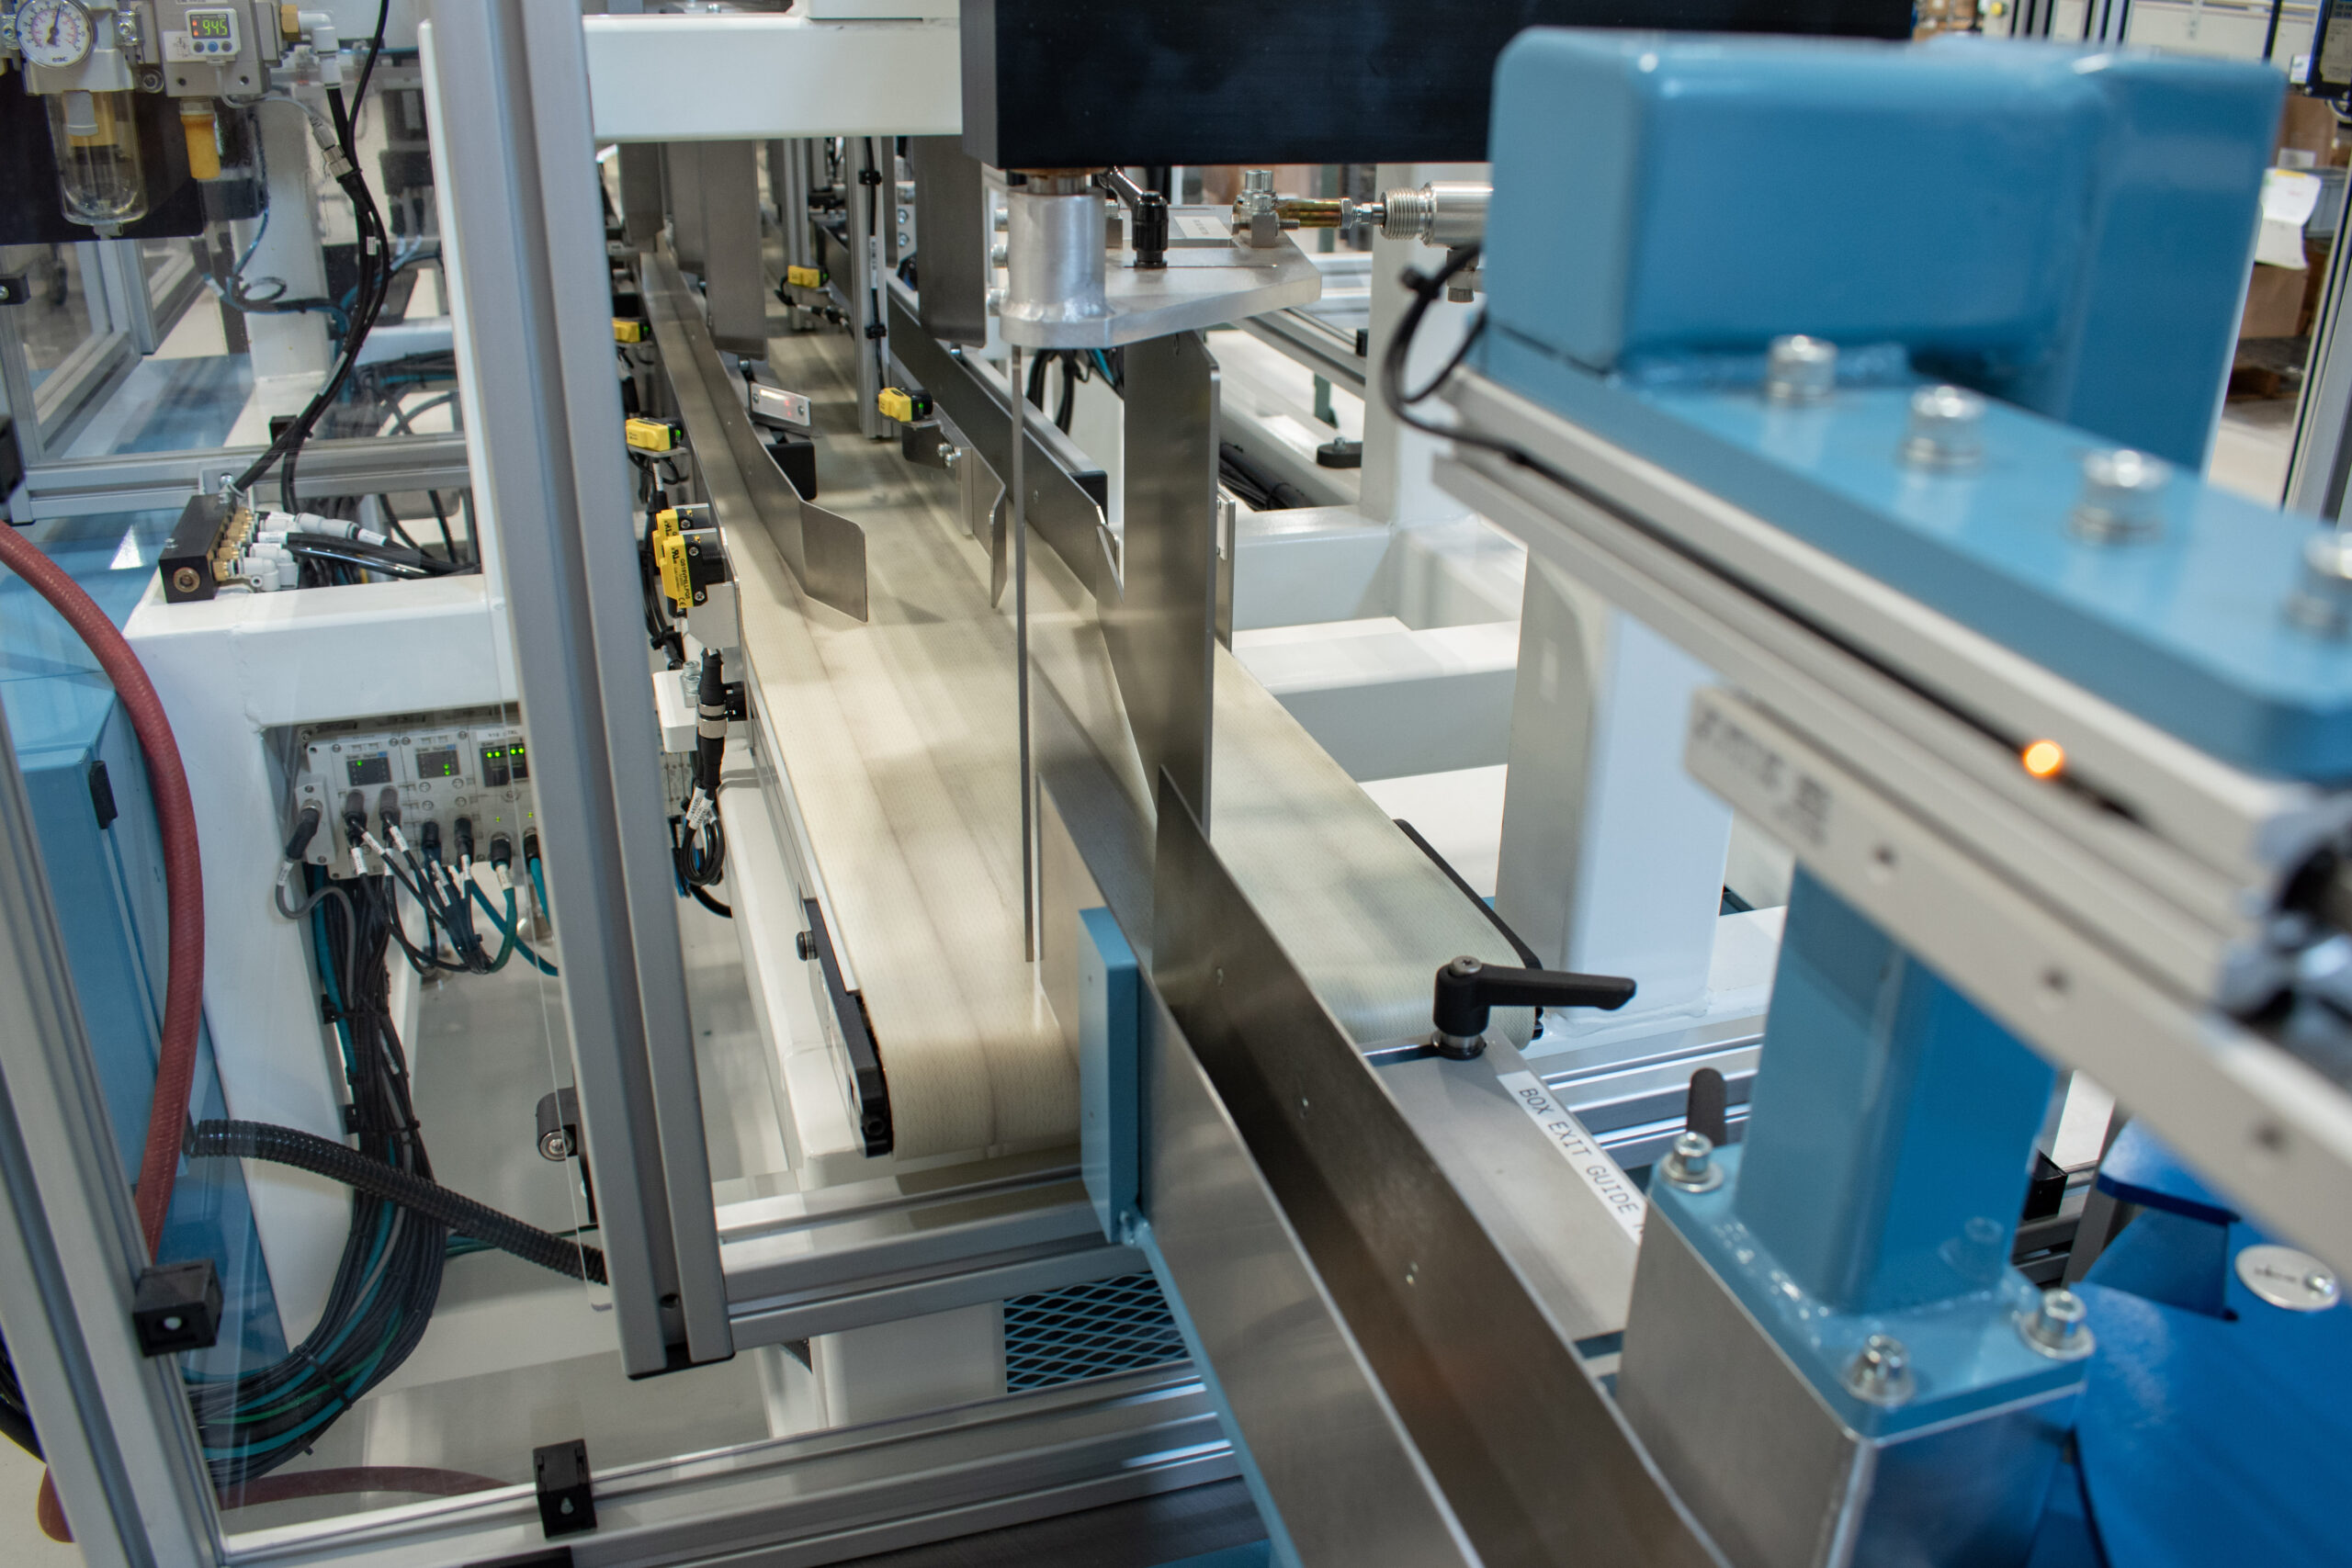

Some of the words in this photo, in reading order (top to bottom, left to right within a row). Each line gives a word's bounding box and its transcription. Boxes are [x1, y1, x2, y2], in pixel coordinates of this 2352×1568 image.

[202, 19, 229, 36] 945
[1519, 1088, 1554, 1115] BOX
[1547, 1121, 1592, 1157] EXIT
[1586, 1165, 1639, 1214] GUIDE
